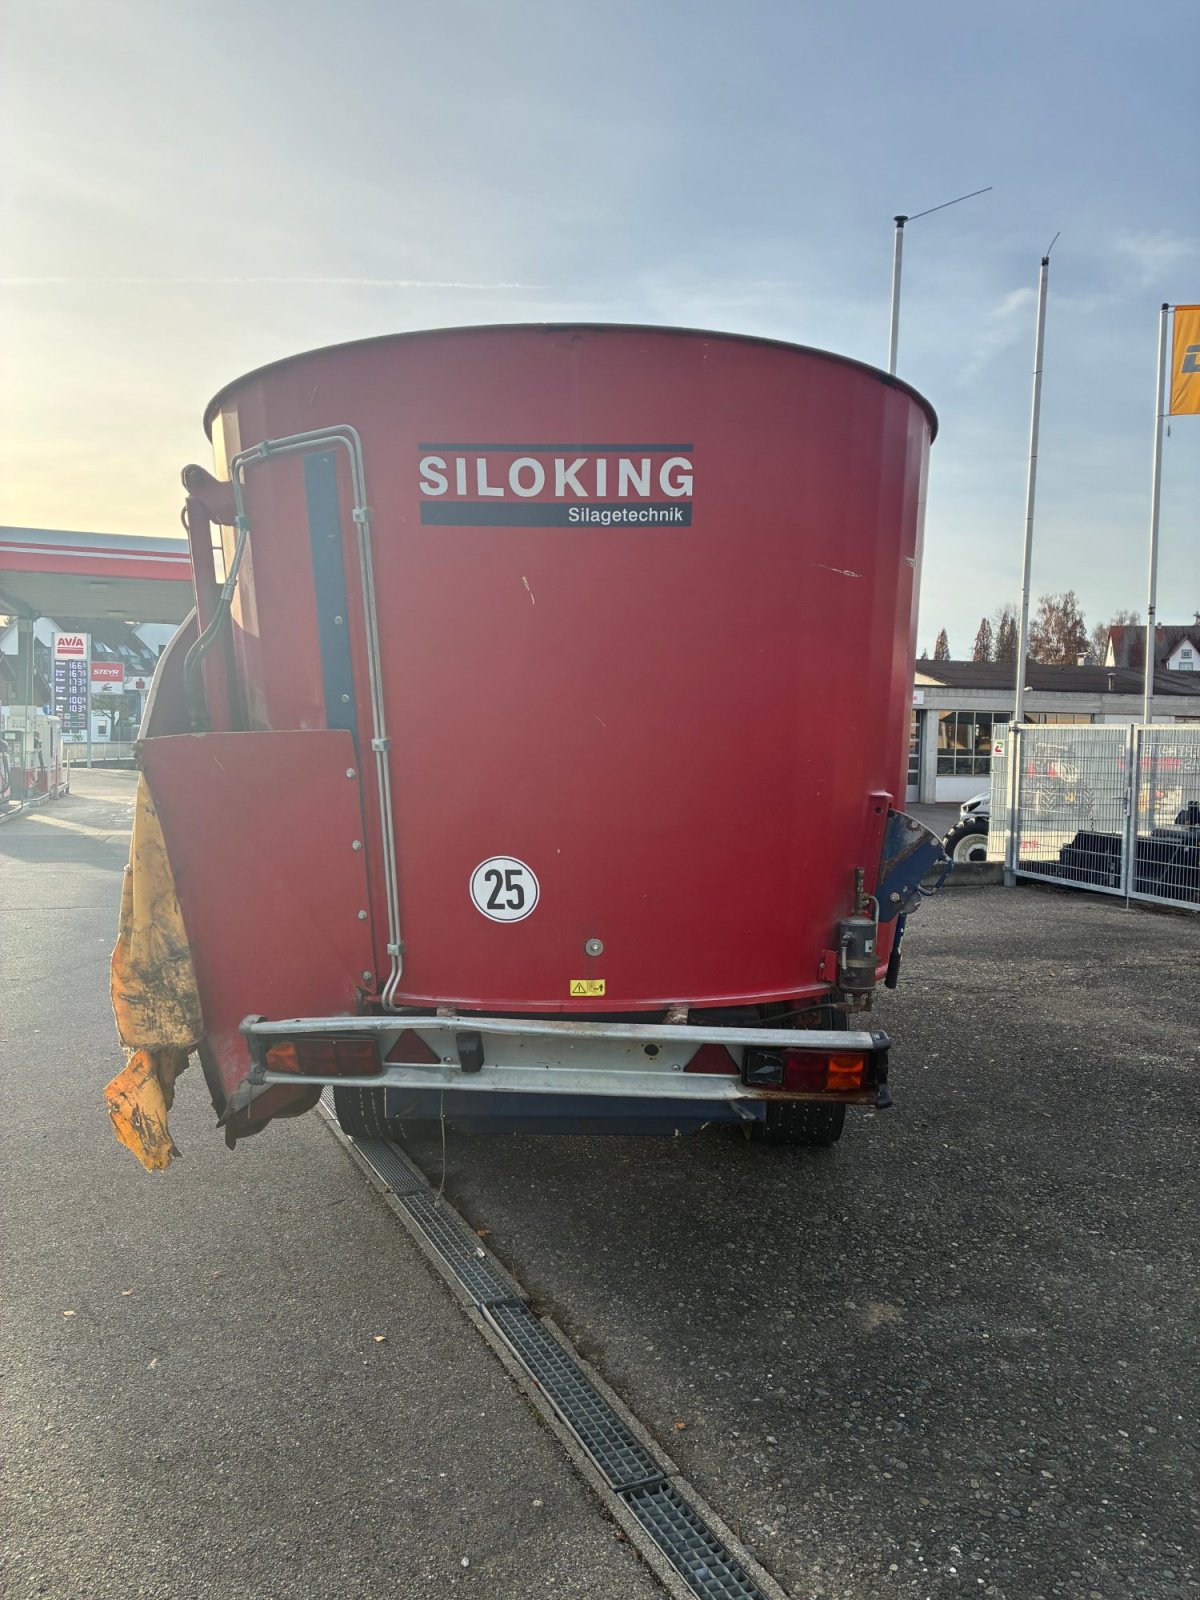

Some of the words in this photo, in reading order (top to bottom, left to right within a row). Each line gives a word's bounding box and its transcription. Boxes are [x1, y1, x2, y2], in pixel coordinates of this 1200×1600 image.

[419, 456, 693, 497] SILOKING
[568, 507, 683, 525] Silagetechnik
[485, 869, 524, 910] 25
